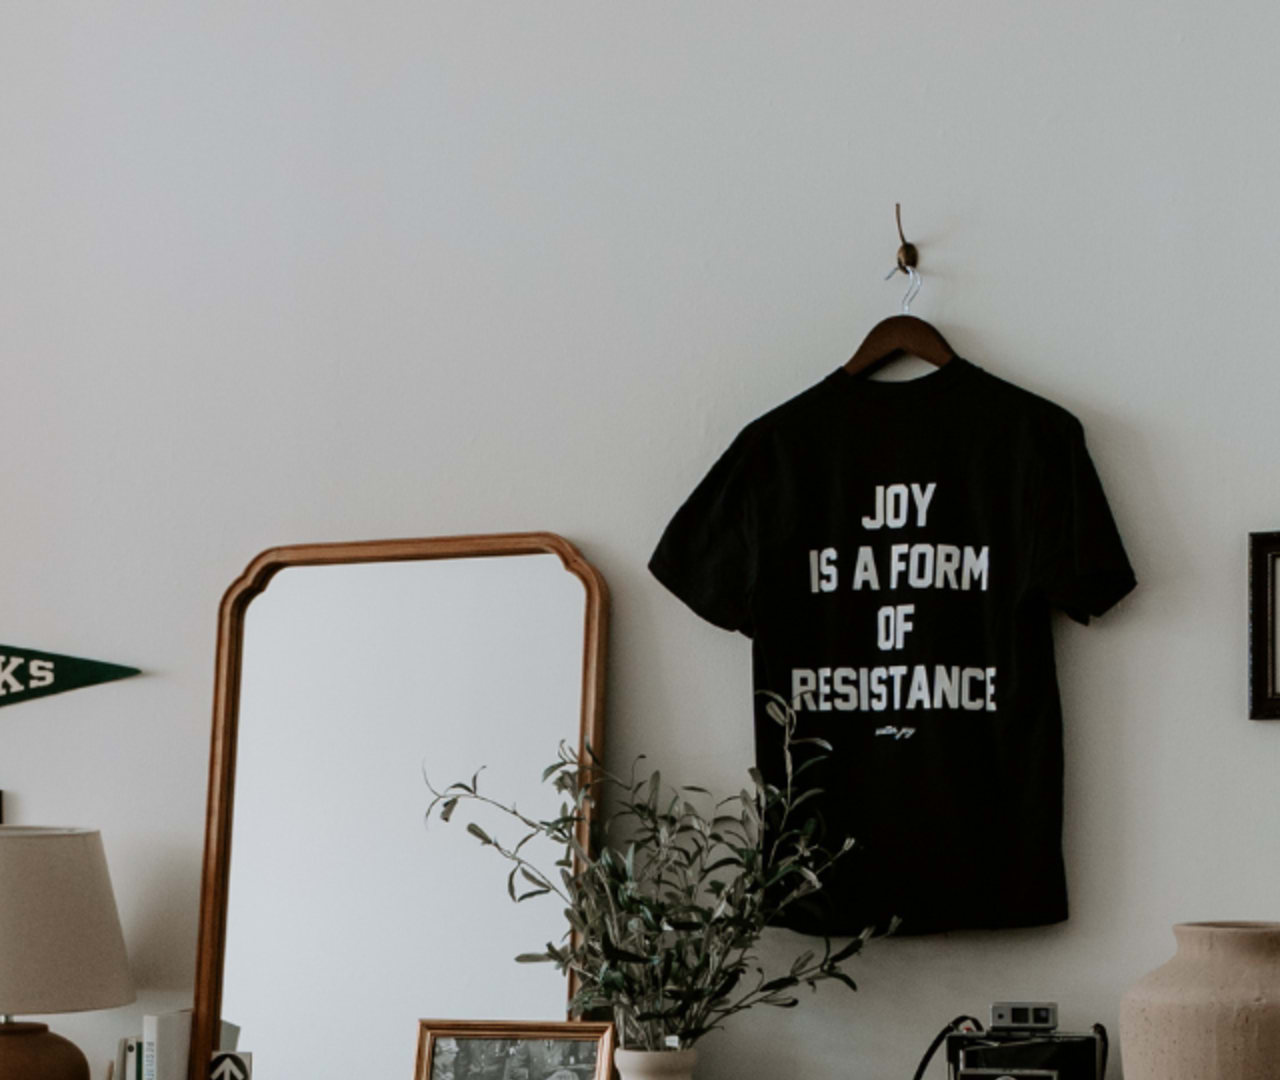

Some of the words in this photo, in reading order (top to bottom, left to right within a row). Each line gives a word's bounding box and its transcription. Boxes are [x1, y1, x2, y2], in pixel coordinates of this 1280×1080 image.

[861, 482, 937, 530] JOY
[809, 547, 838, 593] IS
[852, 546, 880, 590] A
[889, 544, 989, 591] FORM
[877, 604, 915, 651] OF
[791, 665, 997, 712] RESISTANCE
